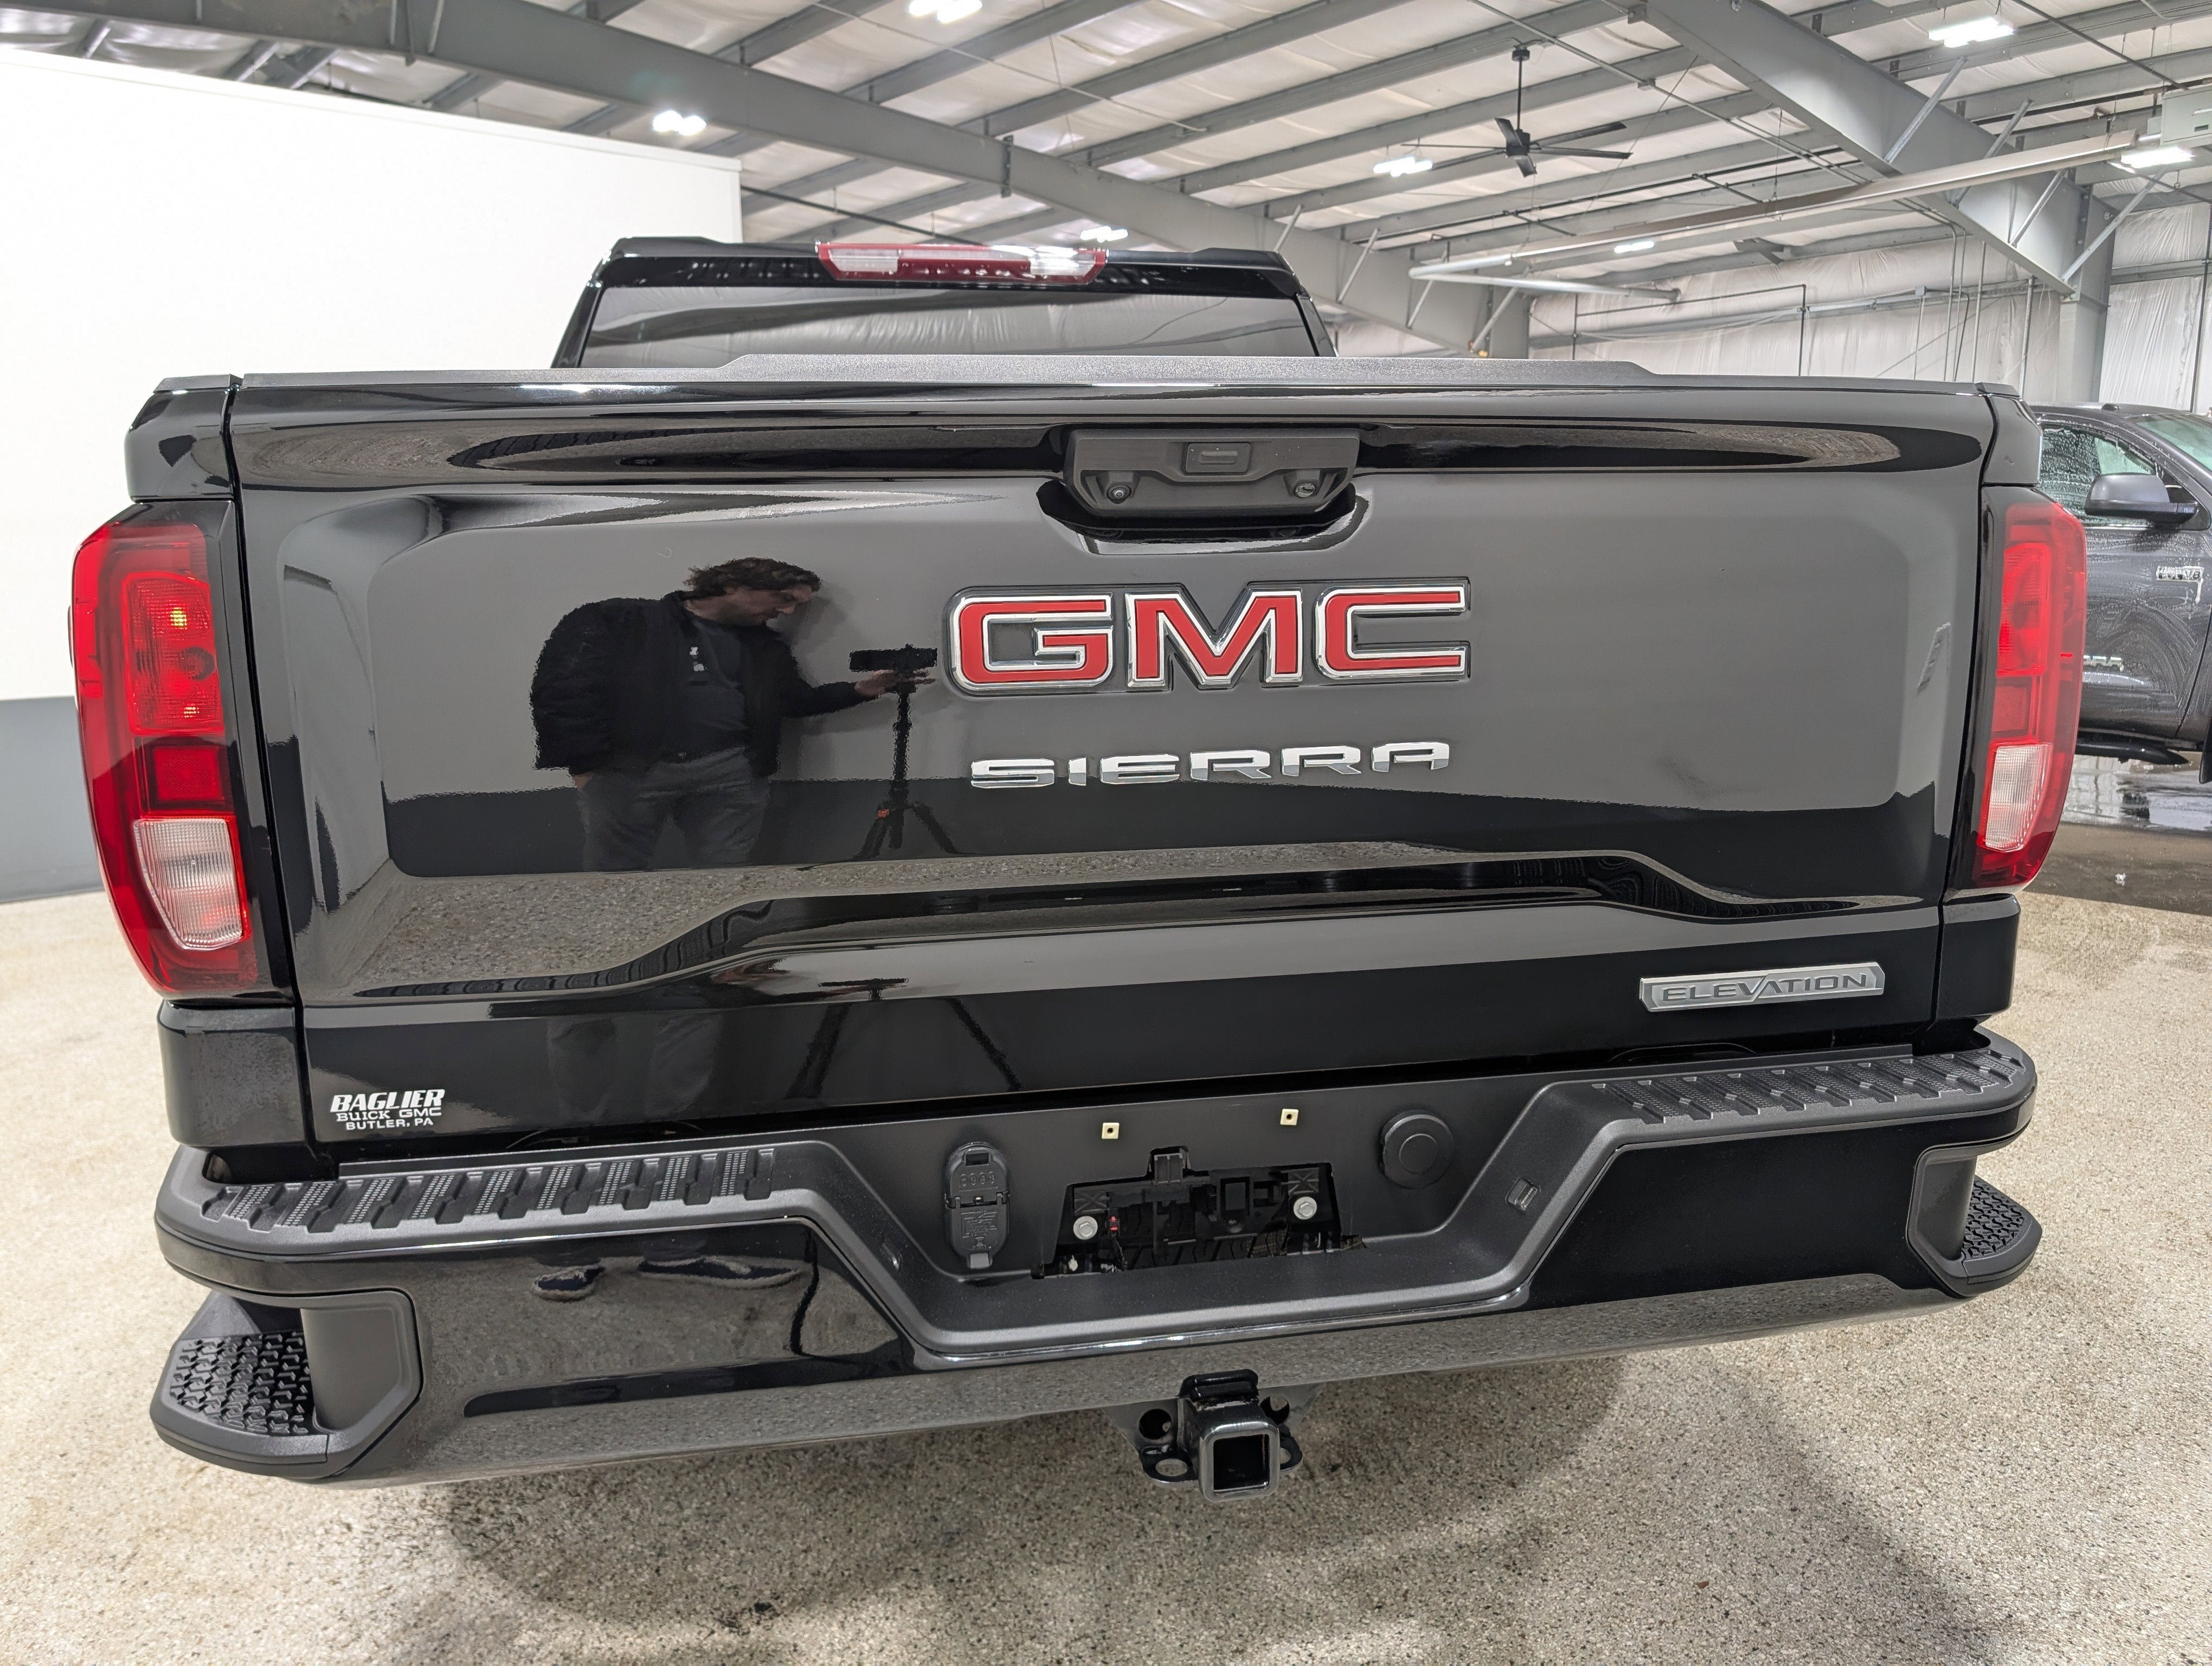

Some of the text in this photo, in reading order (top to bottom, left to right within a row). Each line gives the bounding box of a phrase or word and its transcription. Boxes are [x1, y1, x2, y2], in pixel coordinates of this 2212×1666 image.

[950, 580, 1468, 696] GMC
[970, 741, 1450, 789] SIERRA
[1662, 973, 1867, 1002] ELEVATION
[330, 1088, 446, 1112] BAGLIER
[336, 1107, 442, 1122] BUICK GMC
[345, 1117, 434, 1131] BUTLER, PA
